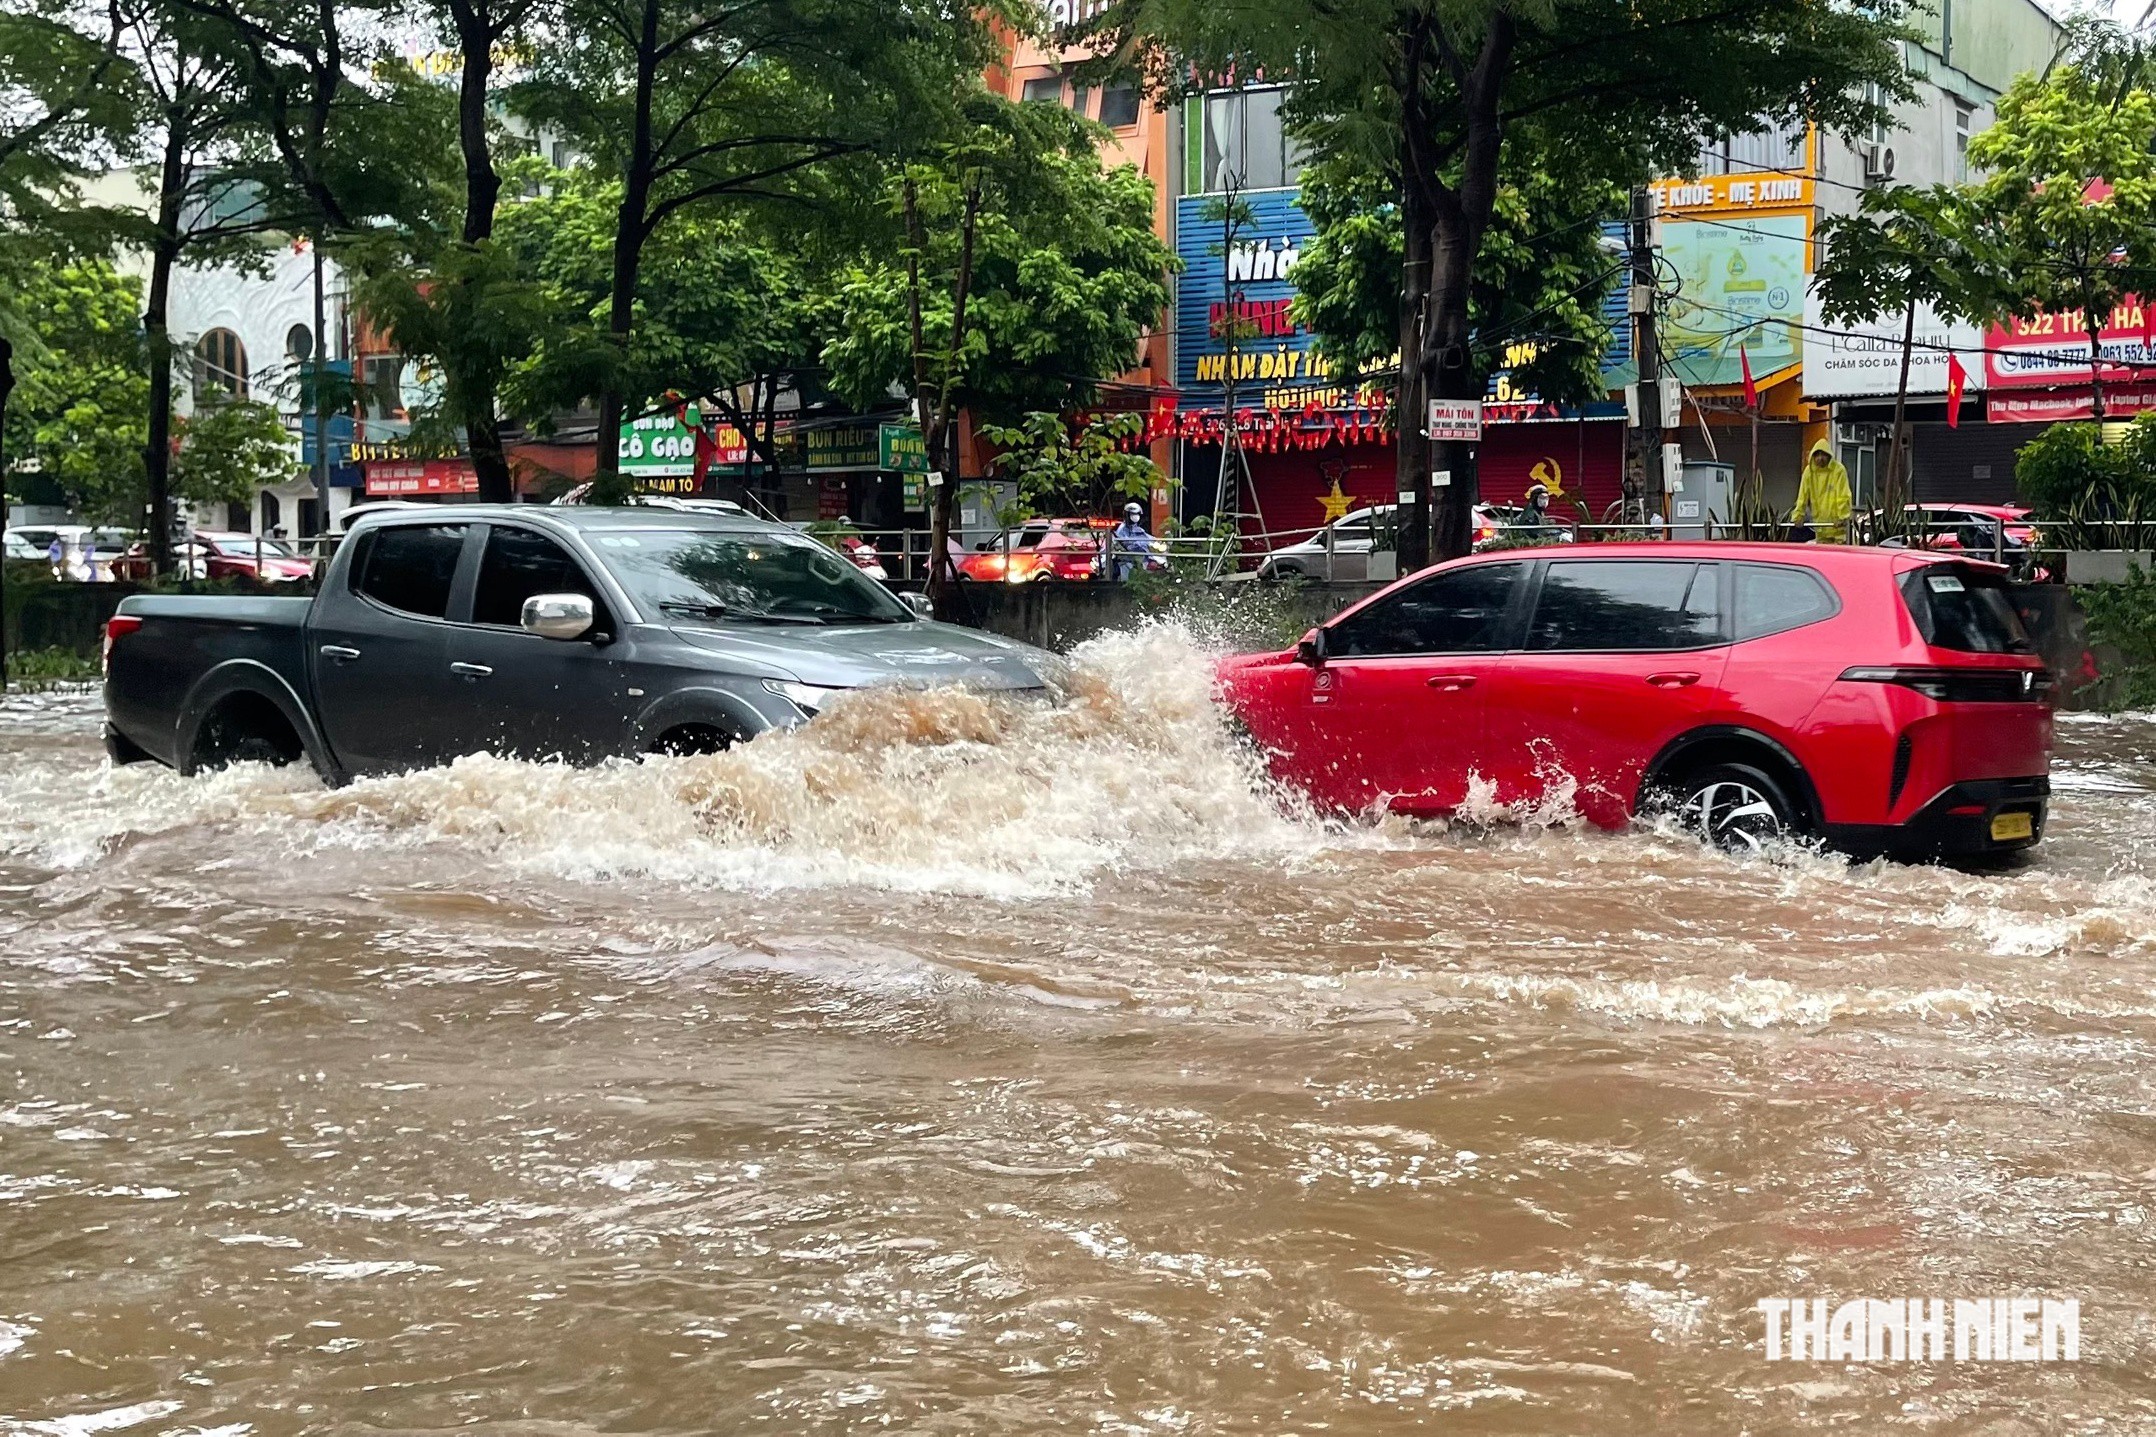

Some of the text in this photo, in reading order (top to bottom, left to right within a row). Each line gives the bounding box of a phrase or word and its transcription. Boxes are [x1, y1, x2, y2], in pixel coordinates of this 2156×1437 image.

[1729, 182, 1755, 205] MẸ
[1759, 180, 1802, 201] XINH
[2018, 313, 2054, 336] 322
[1859, 357, 1881, 368] SÓC
[1884, 358, 1898, 367] DA
[1903, 356, 1930, 366] HOA
[1934, 355, 1949, 366] HỌ
[2125, 344, 2144, 361] 552
[619, 432, 694, 461] CÔ GẠO
[719, 427, 740, 448] CHO
